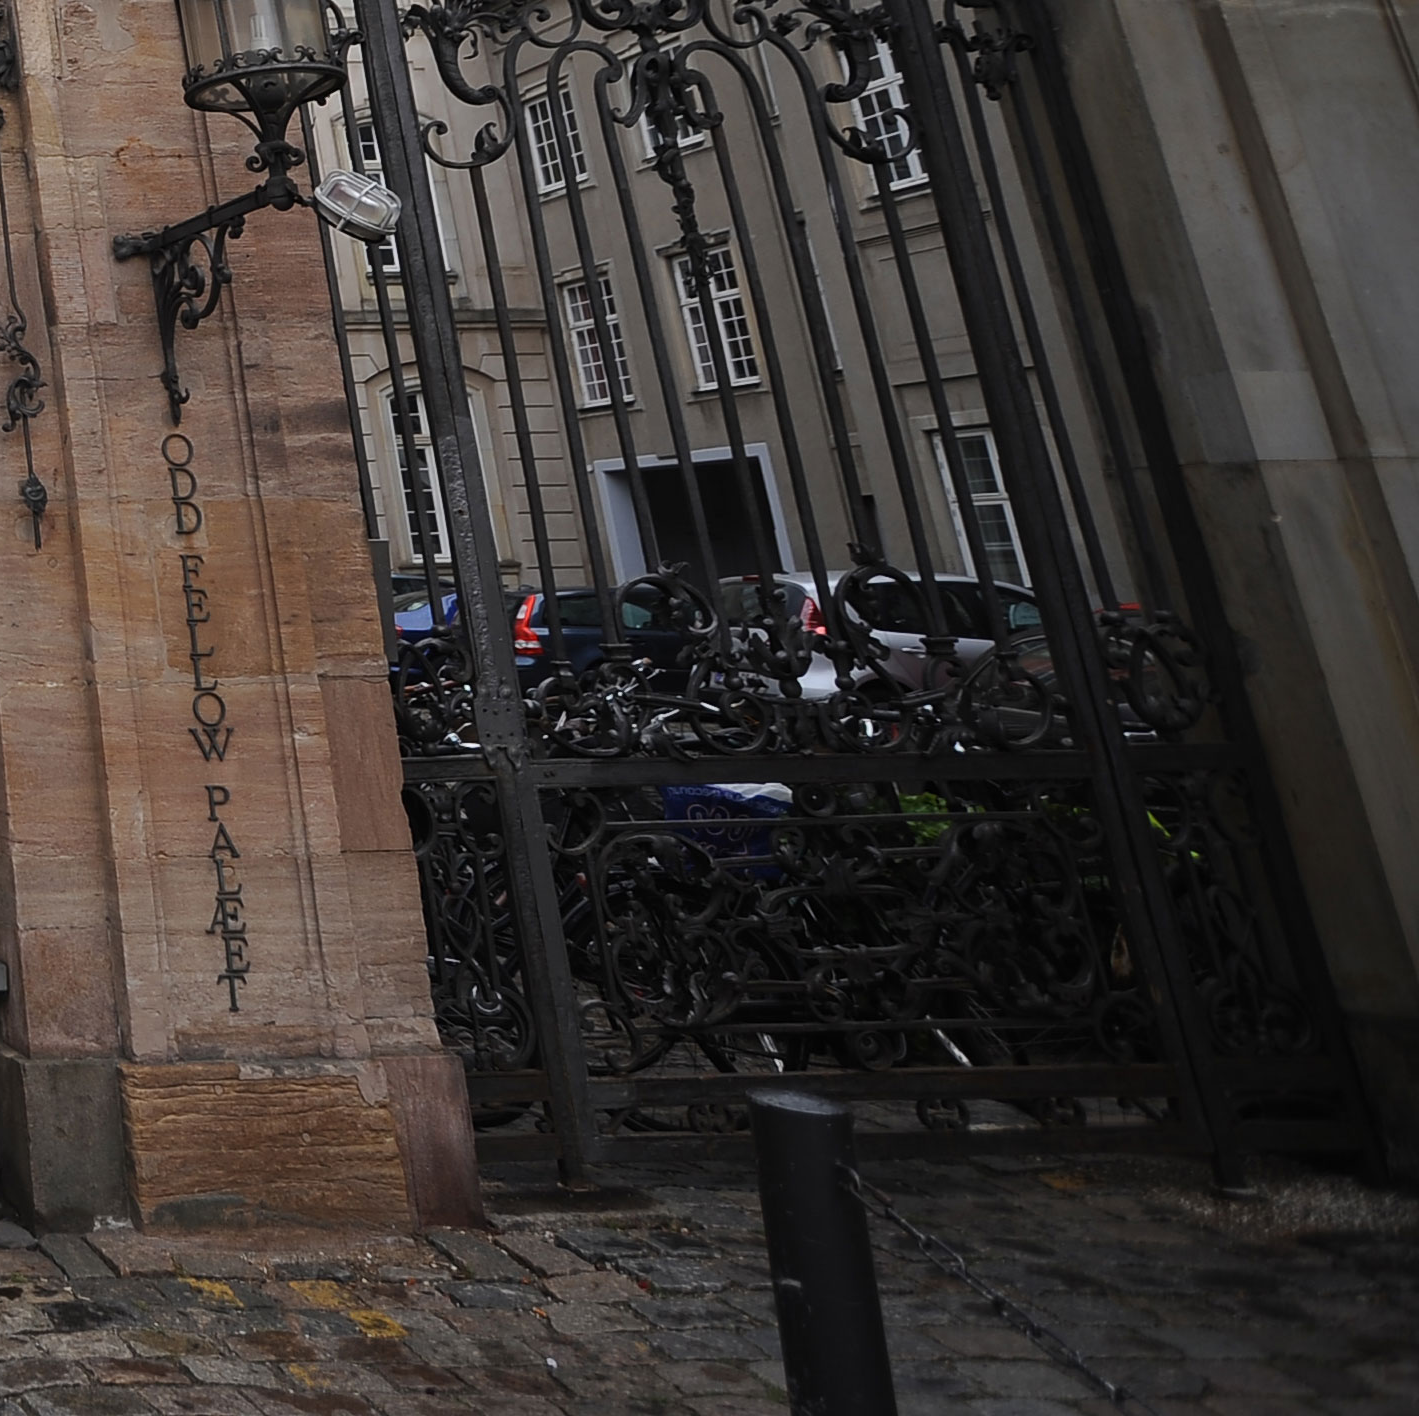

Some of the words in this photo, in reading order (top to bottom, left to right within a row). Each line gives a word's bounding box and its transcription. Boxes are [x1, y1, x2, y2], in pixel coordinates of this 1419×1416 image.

[162, 434, 202, 534] ODD
[179, 554, 234, 762] FELLOW
[205, 785, 250, 1012] PALÆET
